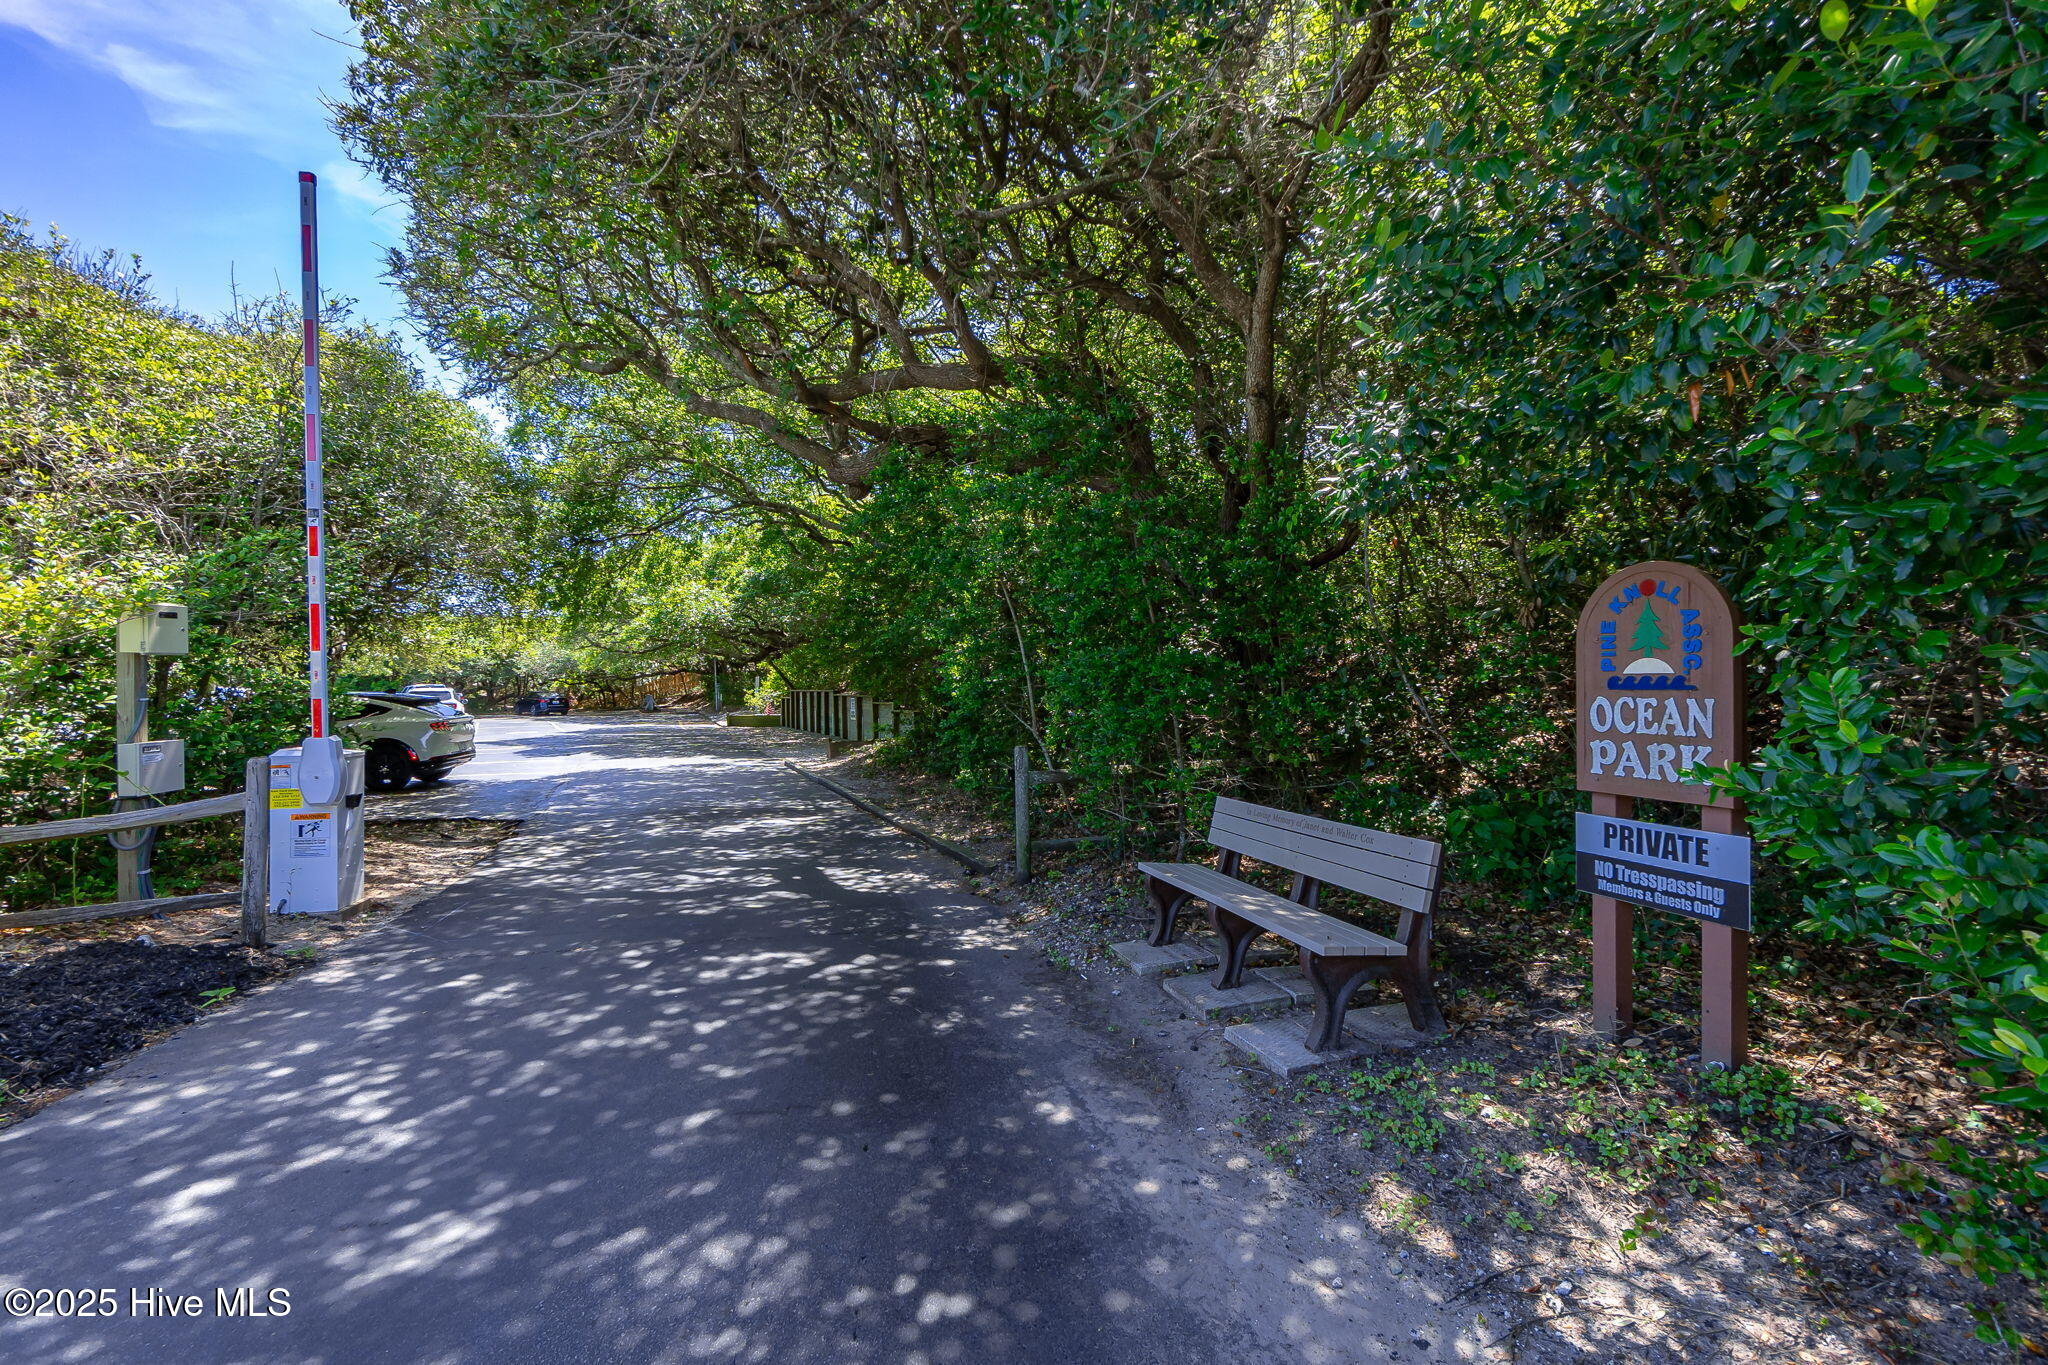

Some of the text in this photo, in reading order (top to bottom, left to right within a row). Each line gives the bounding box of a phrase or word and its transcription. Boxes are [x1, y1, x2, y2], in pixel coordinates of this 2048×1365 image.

[1600, 619, 1617, 673] PINE
[1589, 695, 1716, 739] OCEAN
[1589, 738, 1714, 786] PARK
[1273, 813, 1295, 828] Memory
[1321, 825, 1334, 836] and
[1336, 827, 1358, 841] Walter
[1603, 822, 1710, 868] PRIVATE
[1594, 859, 1725, 906] NO Tresspassing
[1597, 878, 1721, 919] Members & Guests Only
